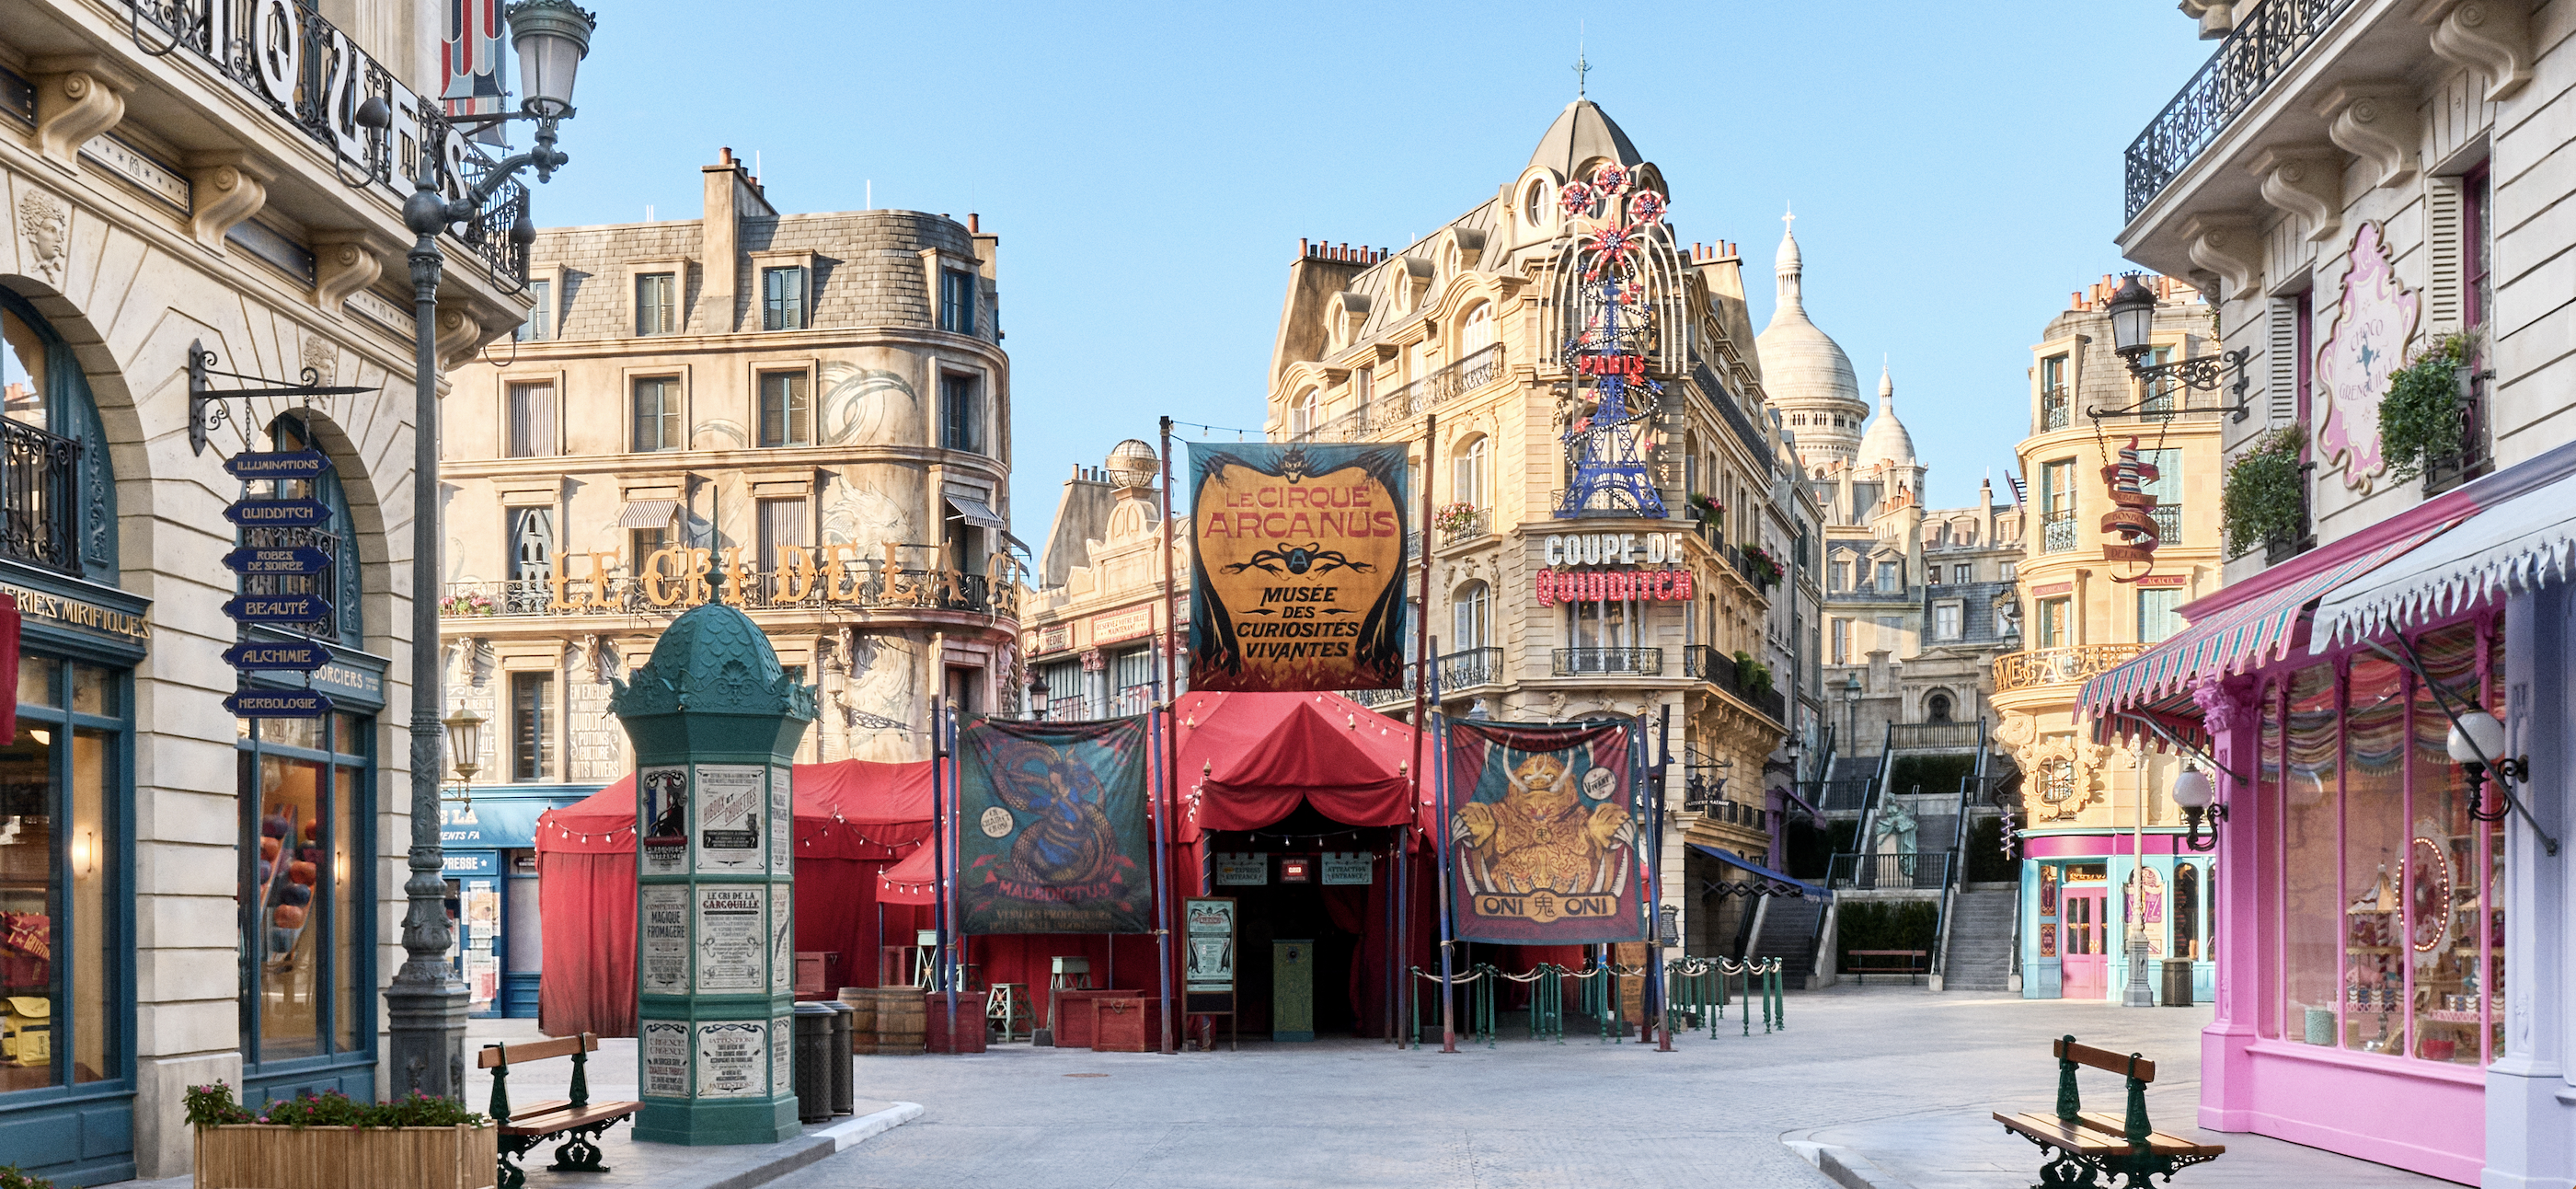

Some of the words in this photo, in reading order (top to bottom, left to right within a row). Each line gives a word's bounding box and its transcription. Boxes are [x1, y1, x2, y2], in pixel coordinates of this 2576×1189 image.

[2350, 318, 2383, 352] CHOCO
[1580, 355, 1645, 375] PARIS
[2340, 352, 2398, 400] GRENOUILLE
[236, 459, 319, 471] ILLUMINATIONS
[1226, 492, 1254, 508] LE
[1257, 486, 1372, 509] CIRQUE
[242, 507, 314, 519] QUIDDITCH
[1203, 511, 1396, 538] ARCANUS
[257, 551, 293, 560] ROBES
[1545, 534, 1635, 565] COUPE
[1647, 532, 1683, 564] DE
[247, 561, 262, 571] DE
[548, 544, 625, 613] LE
[641, 541, 747, 609] CRI
[772, 538, 862, 606] DE
[879, 537, 969, 606] LA
[1260, 583, 1338, 606] MUSÉE
[1536, 568, 1692, 607] QUIDDITCH
[245, 599, 309, 616] BEAUTÉ
[1282, 606, 1315, 618] DES
[62, 600, 151, 639] MIRIFIQUES
[1236, 618, 1360, 637] CURIOSITÉS
[1041, 633, 1064, 647] OMEDIE
[242, 650, 312, 663] ALCHIMIE
[1246, 641, 1349, 662] VIVANTES
[313, 664, 363, 688] SORCIERS
[570, 684, 581, 700] EN
[582, 684, 613, 700] EXCLUS
[239, 698, 316, 709] HERBOLOGIE
[570, 712, 619, 733] QUIDDITCH
[579, 732, 609, 746] POTIONS
[579, 746, 609, 761] CULTURE
[592, 761, 619, 778] DIVERS
[726, 792, 734, 804] ET
[452, 809, 478, 825] LA
[440, 830, 466, 841] ENTS
[442, 857, 478, 871] PRESSE
[998, 880, 1110, 901] MALEDICTUS
[703, 900, 760, 909] GARGOUILLE
[1483, 898, 1524, 915] ONI
[1534, 893, 1555, 918] 鬼
[1565, 898, 1607, 915] ONI
[651, 911, 681, 924] MAGIQUE
